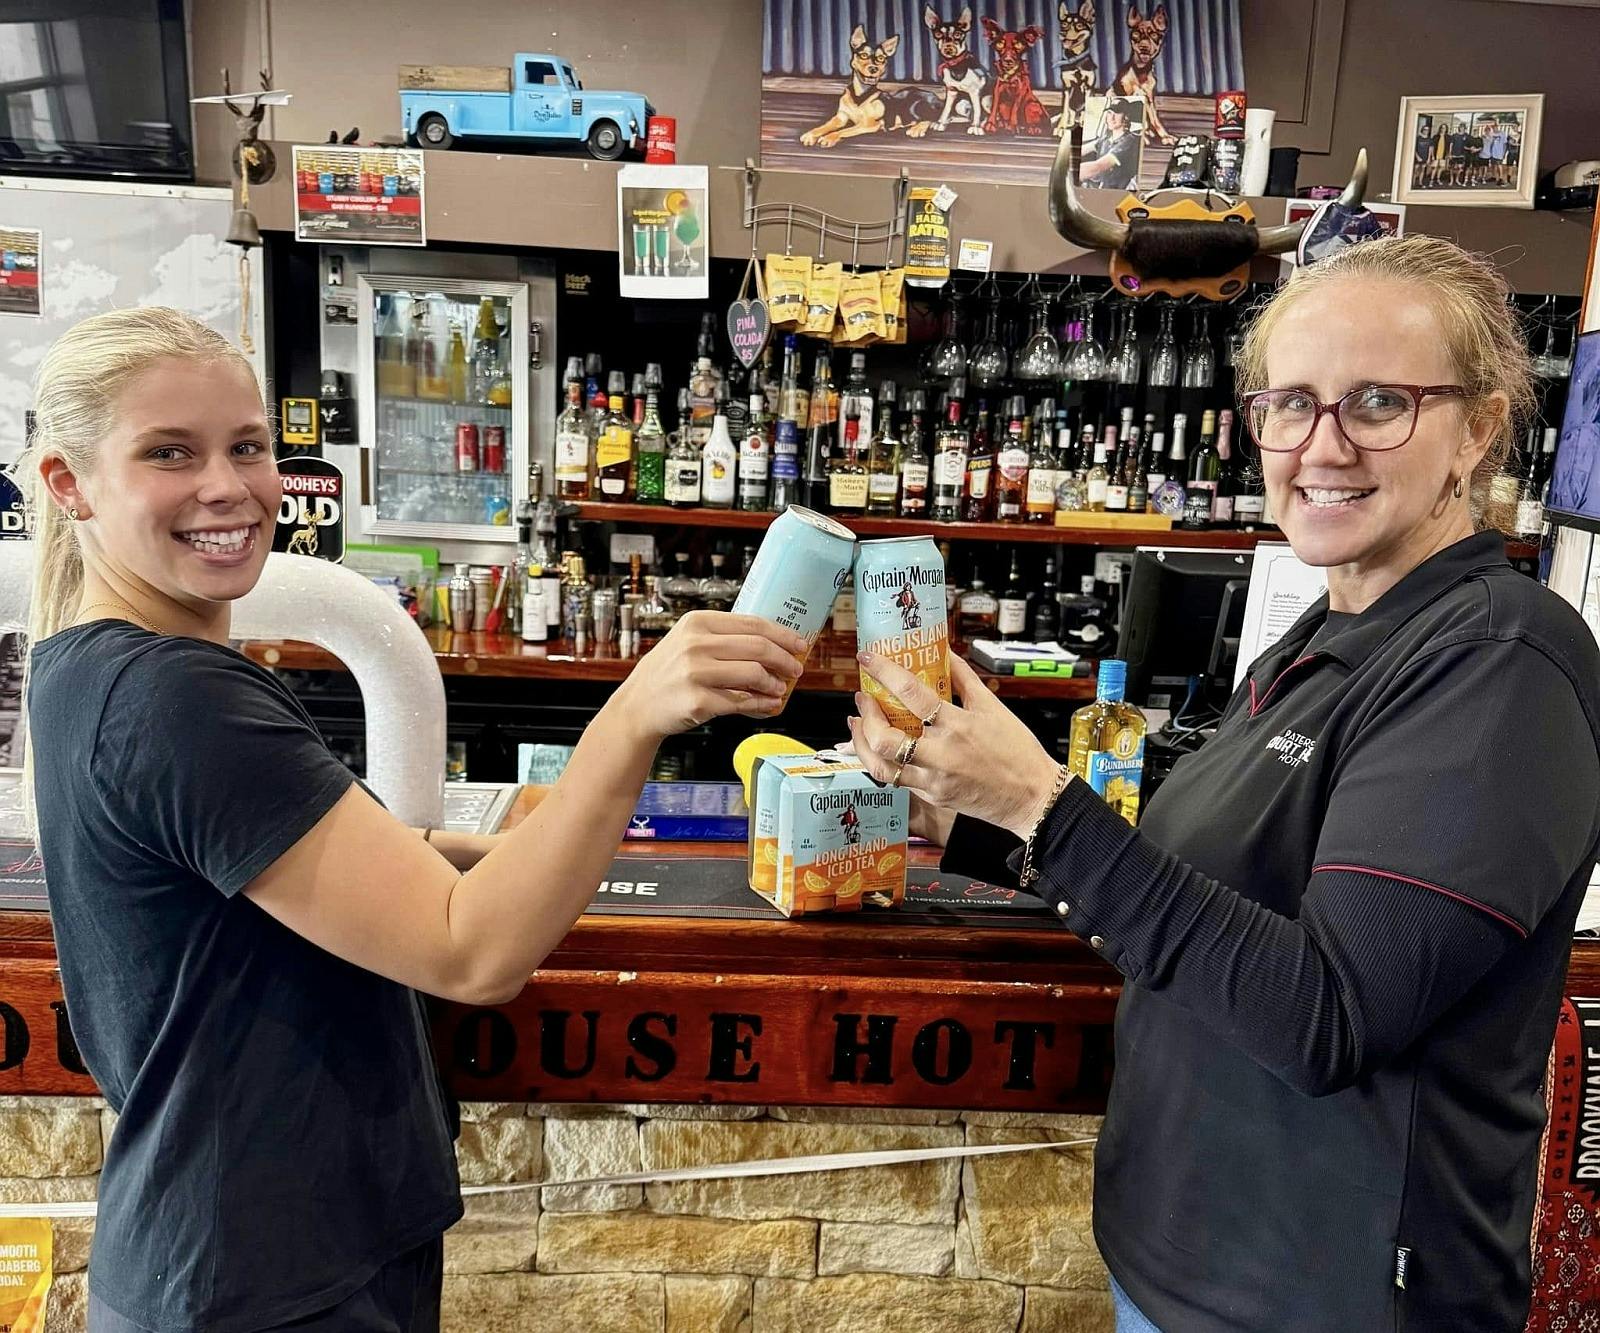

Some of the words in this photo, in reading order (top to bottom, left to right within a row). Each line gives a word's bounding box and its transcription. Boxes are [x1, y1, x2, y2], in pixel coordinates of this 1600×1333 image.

[909, 223, 950, 238] RATED
[915, 213, 944, 224] HARD
[862, 567, 906, 593] Captain
[917, 644, 941, 667] TEA
[810, 791, 853, 814] Captain
[853, 788, 894, 809] Morgan
[815, 846, 845, 868] LONG
[848, 836, 888, 859] ISLAND
[827, 861, 853, 879] ICED
[856, 853, 876, 872] TEA
